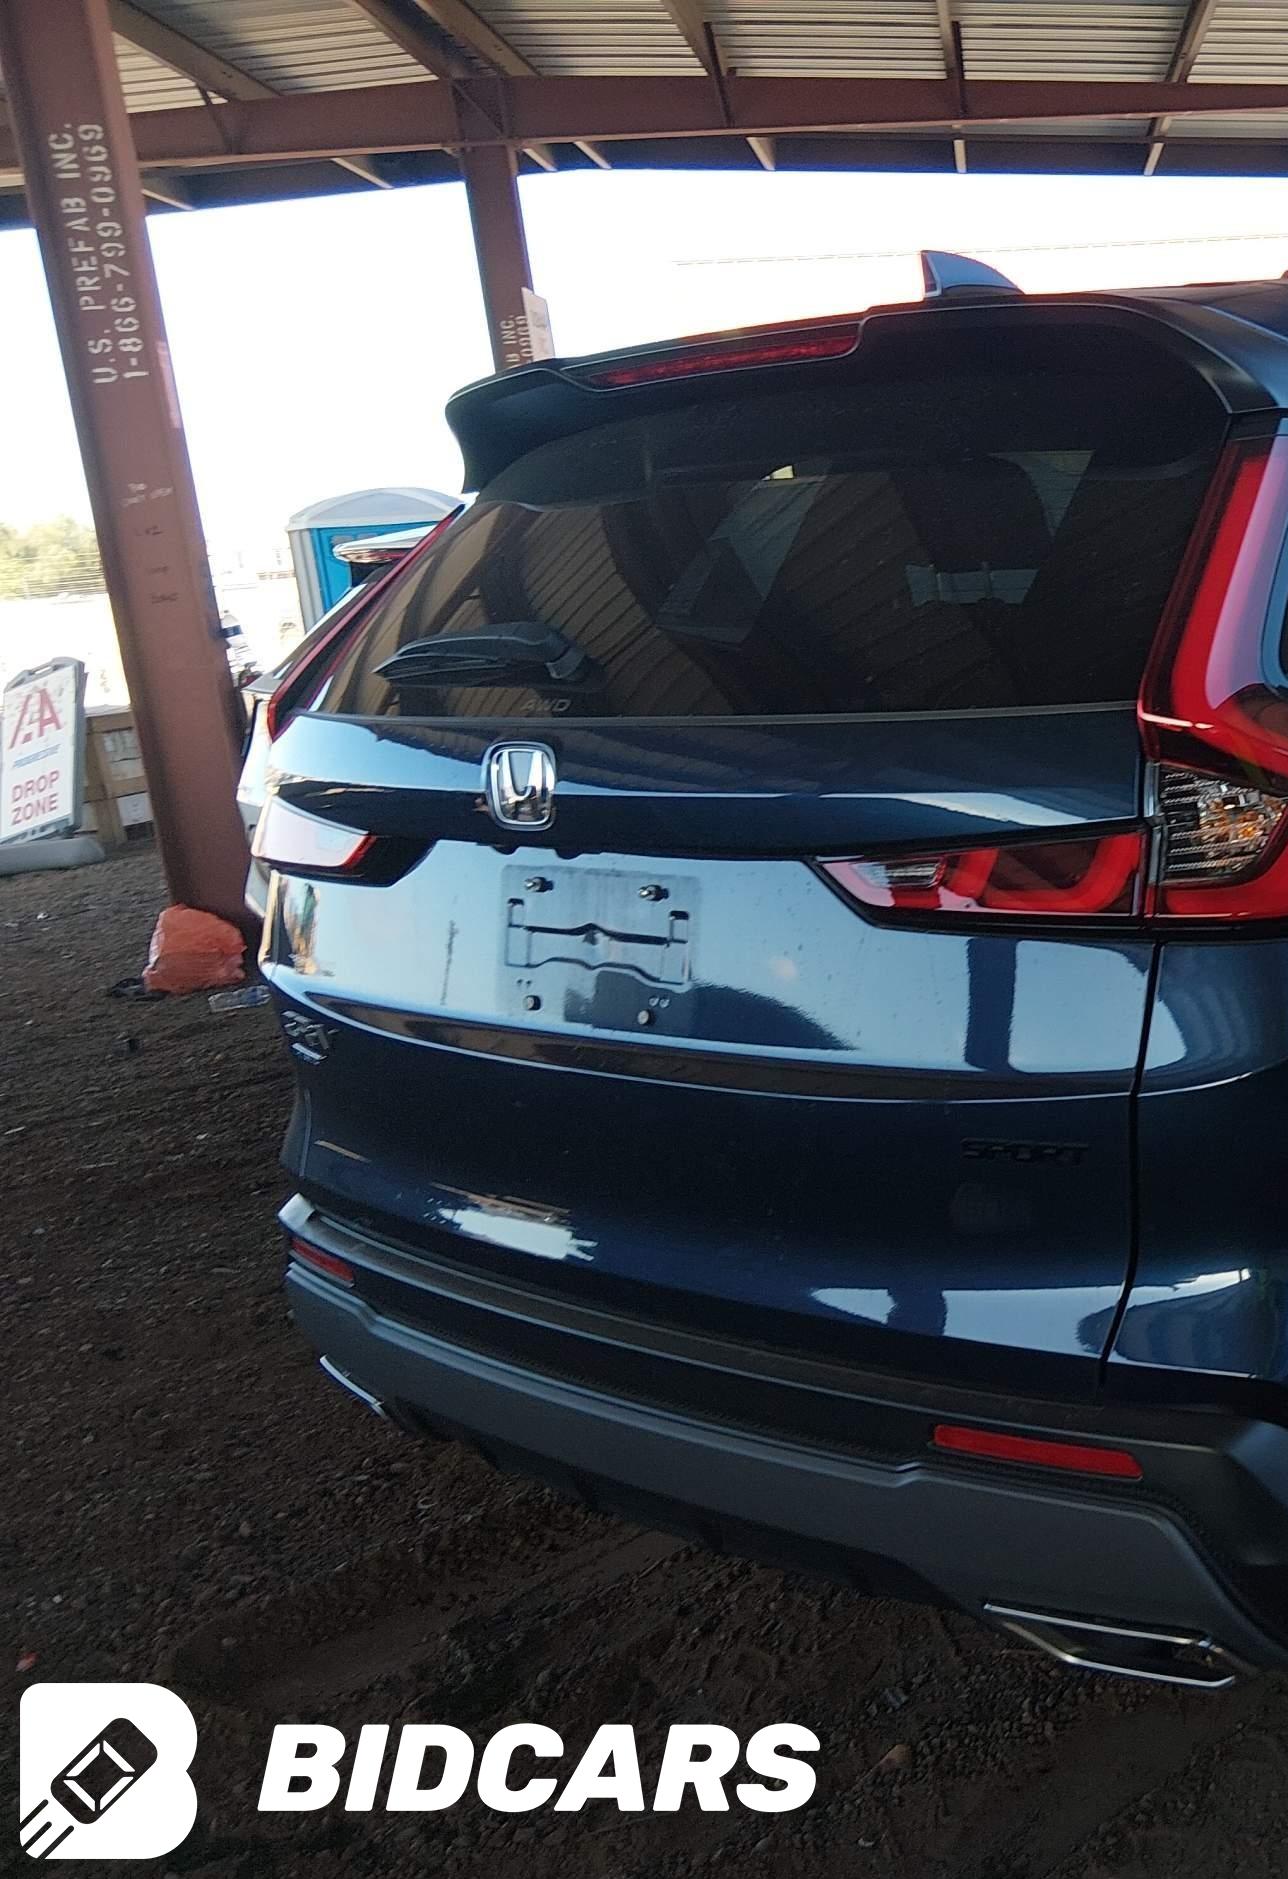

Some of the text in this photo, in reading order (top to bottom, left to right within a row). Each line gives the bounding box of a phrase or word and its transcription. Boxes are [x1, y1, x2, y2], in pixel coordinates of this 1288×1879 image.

[48, 123, 119, 384] U.S. PREFAB INC.
[77, 124, 149, 379] 1-866-799-0969
[11, 769, 61, 803] DROP
[11, 793, 60, 826] ZONE
[960, 1136, 1089, 1166] SPORT
